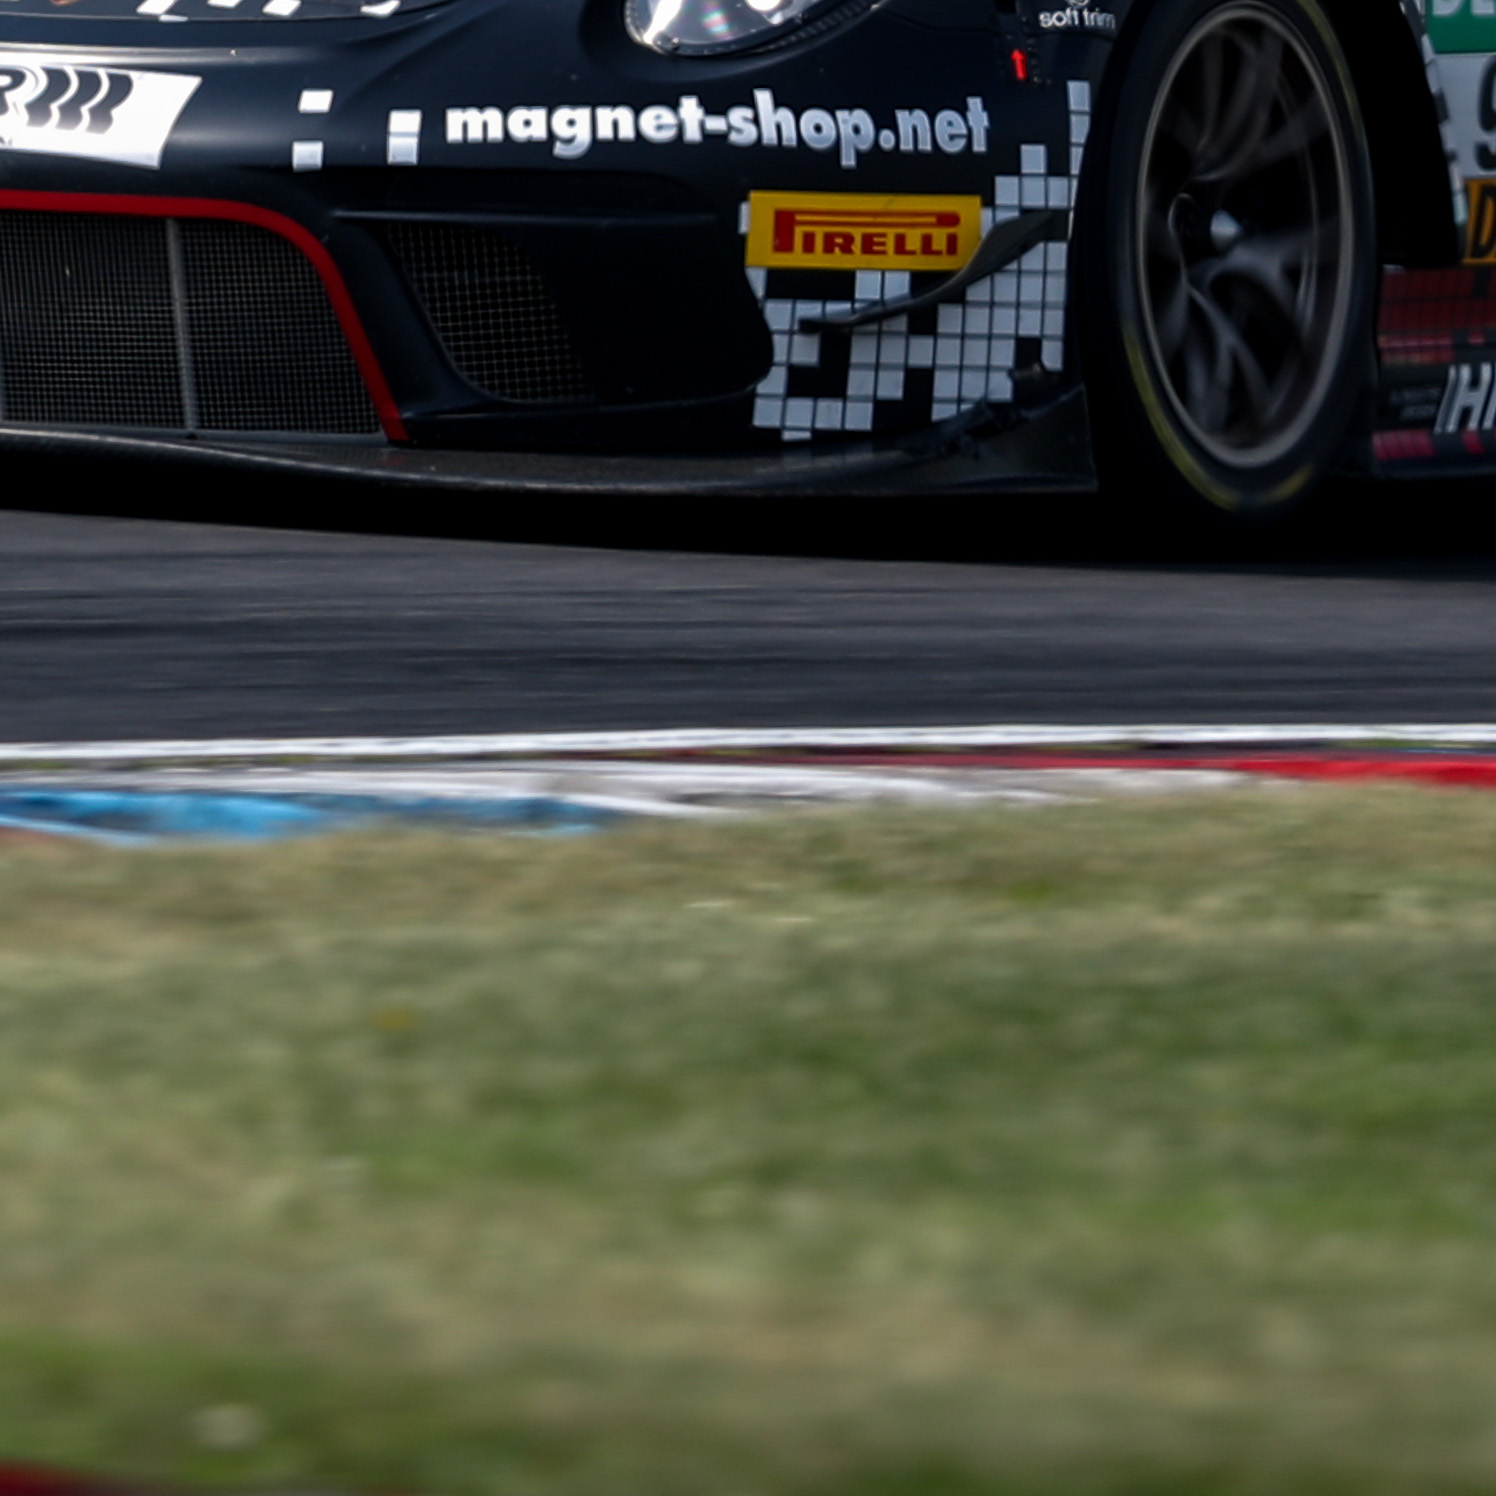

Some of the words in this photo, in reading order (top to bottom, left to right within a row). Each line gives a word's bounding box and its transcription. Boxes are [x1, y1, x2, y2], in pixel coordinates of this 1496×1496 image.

[1038, 7, 1079, 29] soft
[1083, 7, 1116, 29] trim
[446, 89, 989, 168] magnet-shop.net
[773, 209, 961, 256] PIRELLI
